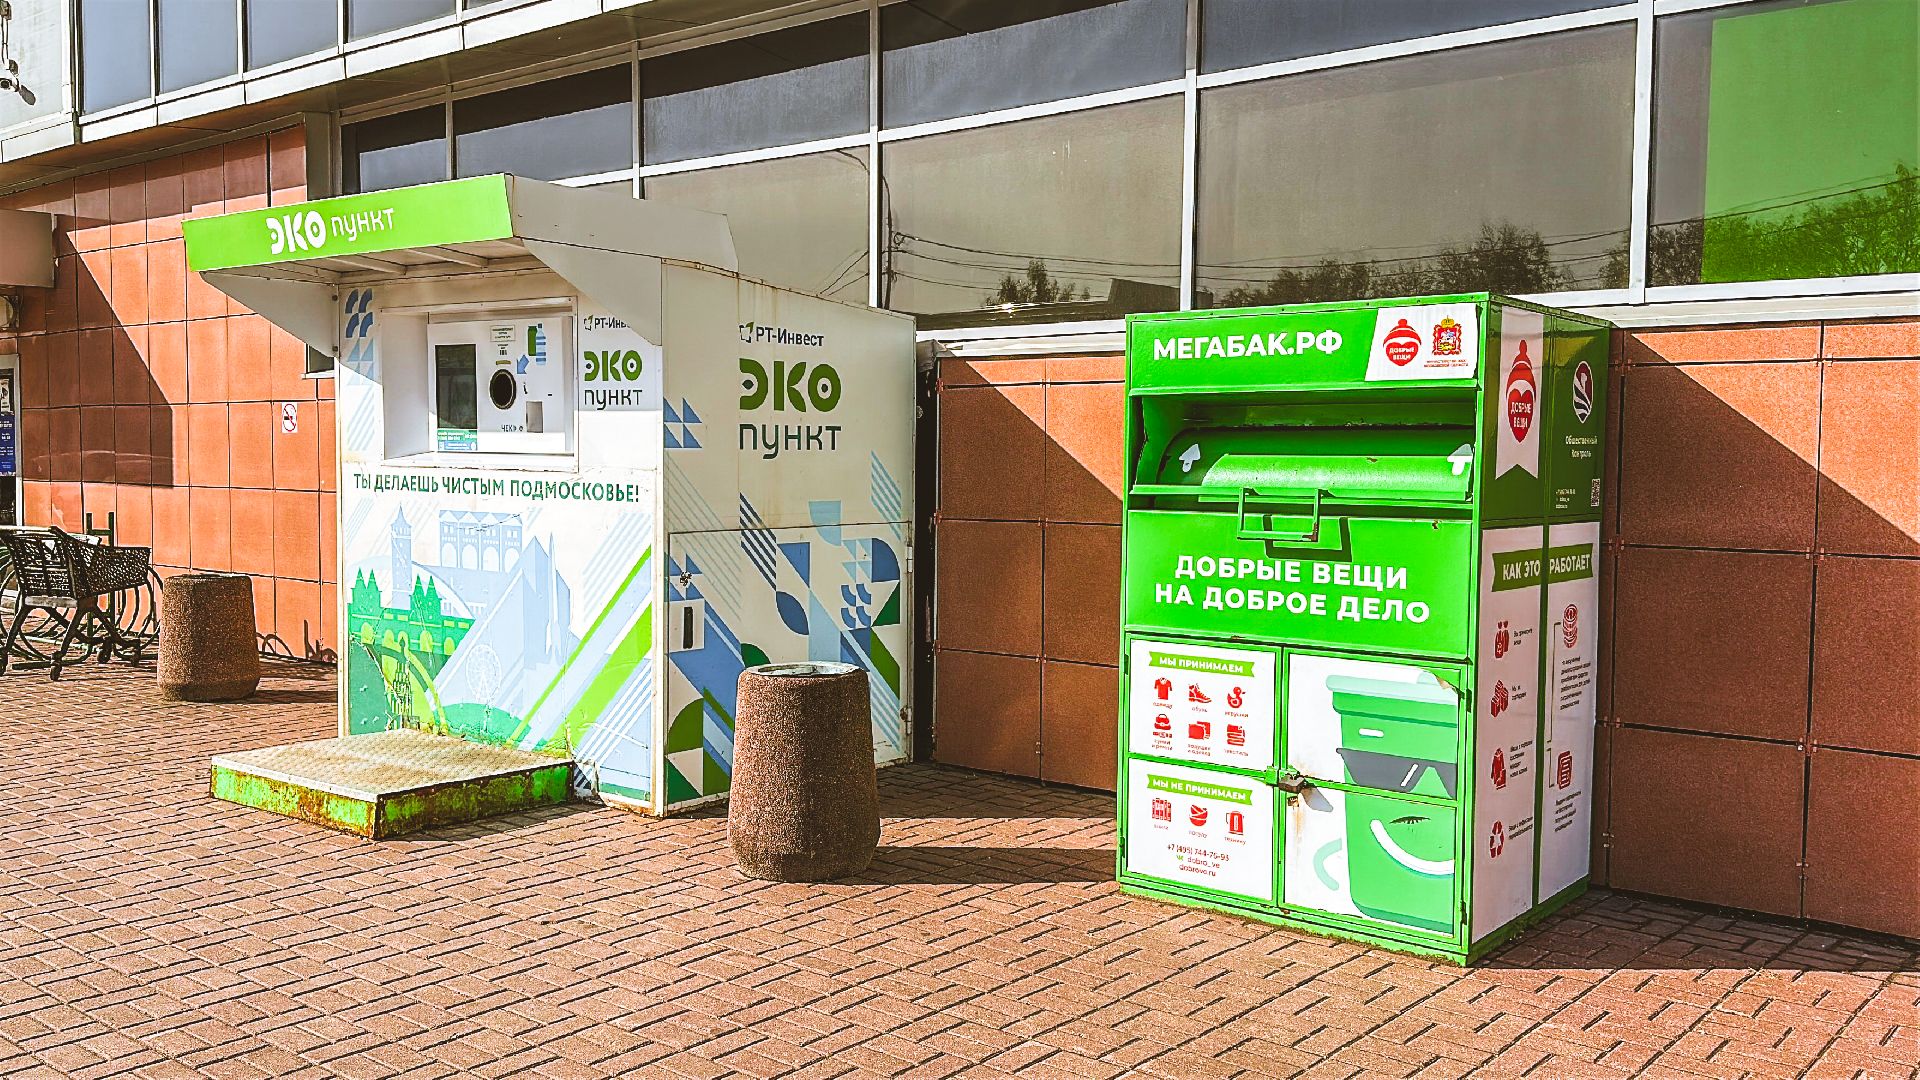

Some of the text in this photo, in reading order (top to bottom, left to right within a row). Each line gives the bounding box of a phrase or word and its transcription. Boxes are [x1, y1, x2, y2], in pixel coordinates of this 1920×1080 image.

[266, 210, 326, 255] ЭКО
[756, 326, 825, 347] РТ-Инвест
[1153, 328, 1343, 361] МЕГАБАК.РФ
[1389, 346, 1415, 354] ДОБРЫЕ
[583, 350, 643, 382] ЭКО
[1393, 353, 1412, 361] ВЕЩИ
[739, 357, 842, 413] ЭКО
[1511, 401, 1532, 416] ДОБРЫЕ
[1513, 416, 1529, 430] ВЕЩИ
[354, 473, 640, 503] ТЫ ДЕЛАЕШЬ ЧИСТЫМ ПОДМОСКОВЬЕ!
[1175, 554, 1408, 590] ДОБРЫЕ ВЕЩИ
[1502, 553, 1591, 581] КАК ЭТО РАБОТАЕТ
[1155, 583, 1431, 624] НА ДОБРОЕ ДЕЛО
[1159, 656, 1244, 674] МЫ ПРИНИМАЕМ
[1152, 779, 1246, 801] МЫ НЕ ПРИНИМАЕМ
